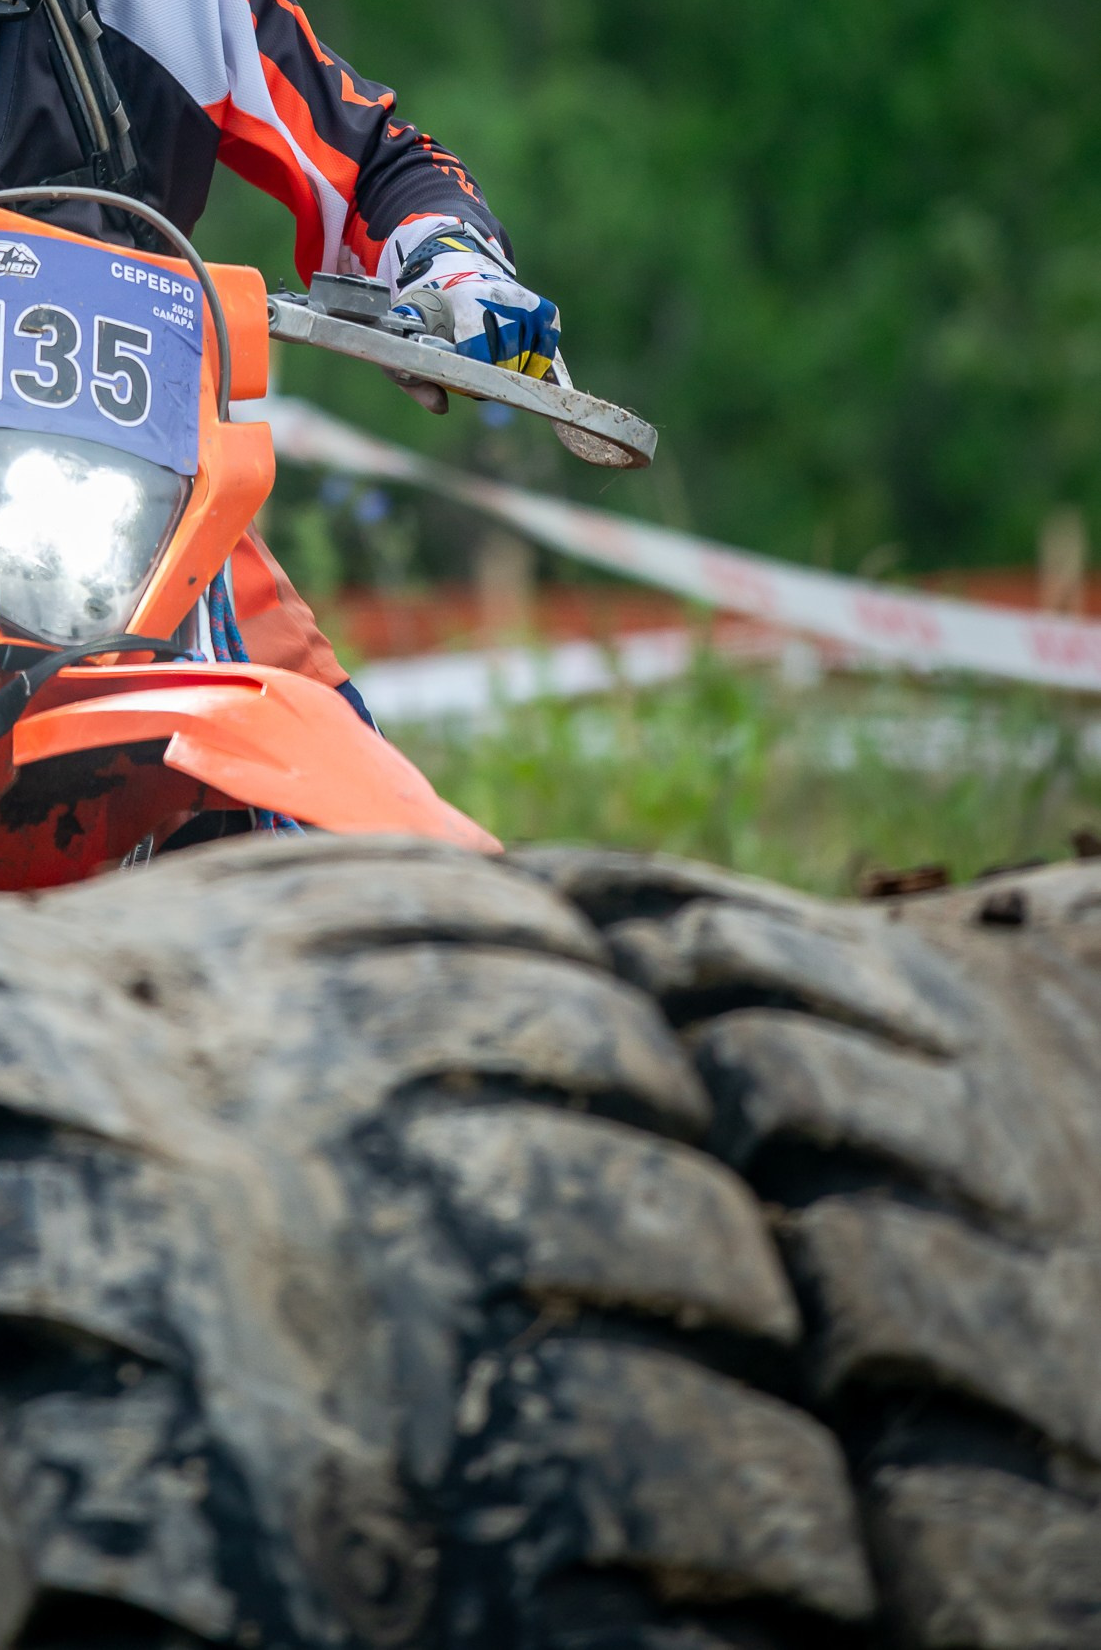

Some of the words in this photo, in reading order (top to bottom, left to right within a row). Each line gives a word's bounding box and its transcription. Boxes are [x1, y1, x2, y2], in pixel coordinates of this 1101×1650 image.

[111, 261, 194, 303] СЕРЕБРО
[152, 306, 194, 331] САМАРА
[171, 302, 194, 320] 2025
